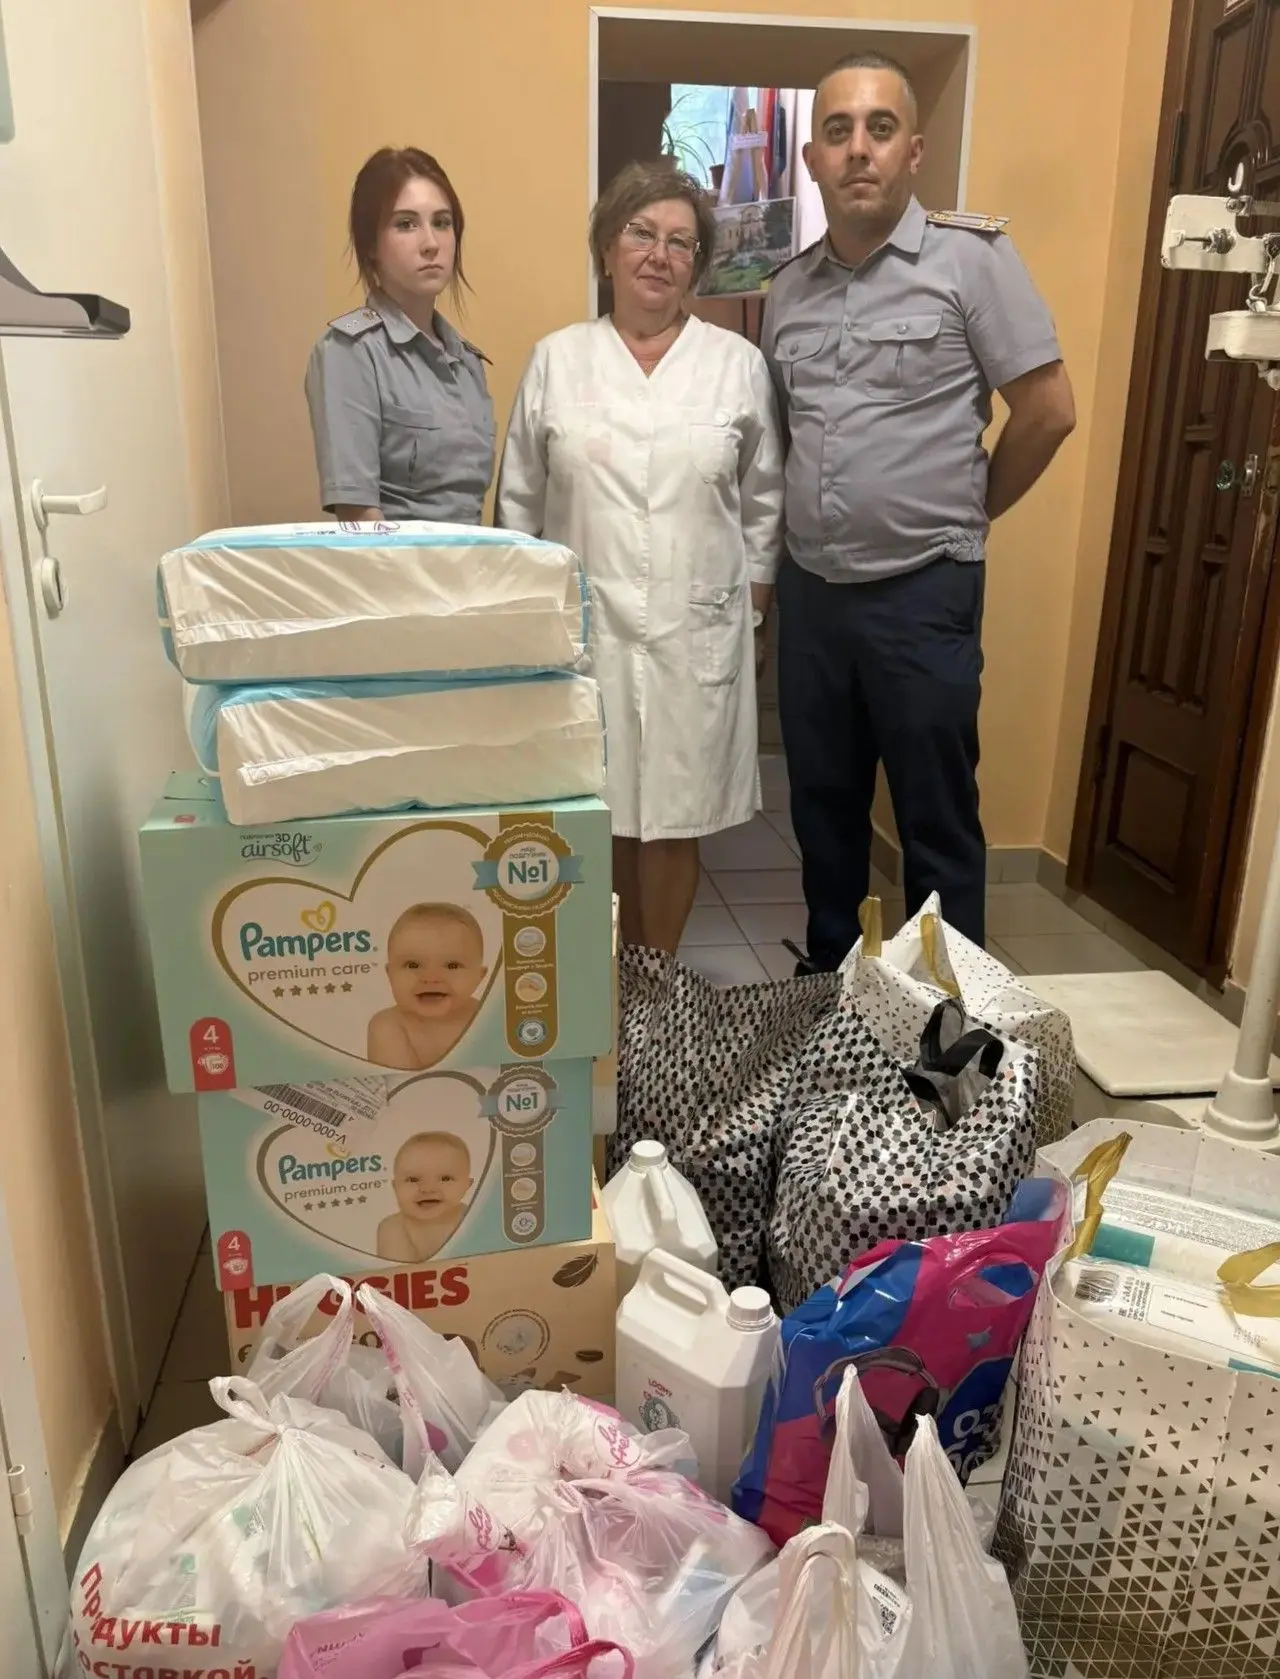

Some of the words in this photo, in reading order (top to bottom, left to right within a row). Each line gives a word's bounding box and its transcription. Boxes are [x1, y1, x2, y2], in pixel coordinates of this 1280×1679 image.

[241, 832, 311, 862] airsoft
[274, 833, 290, 843] 3D
[239, 922, 371, 961] Pampers
[247, 965, 326, 985] premium
[331, 962, 371, 976] care
[203, 1025, 220, 1044] 4
[278, 1154, 382, 1185] Pampers
[284, 1184, 347, 1203] premium
[350, 1180, 382, 1192] care
[227, 1236, 241, 1250] 4
